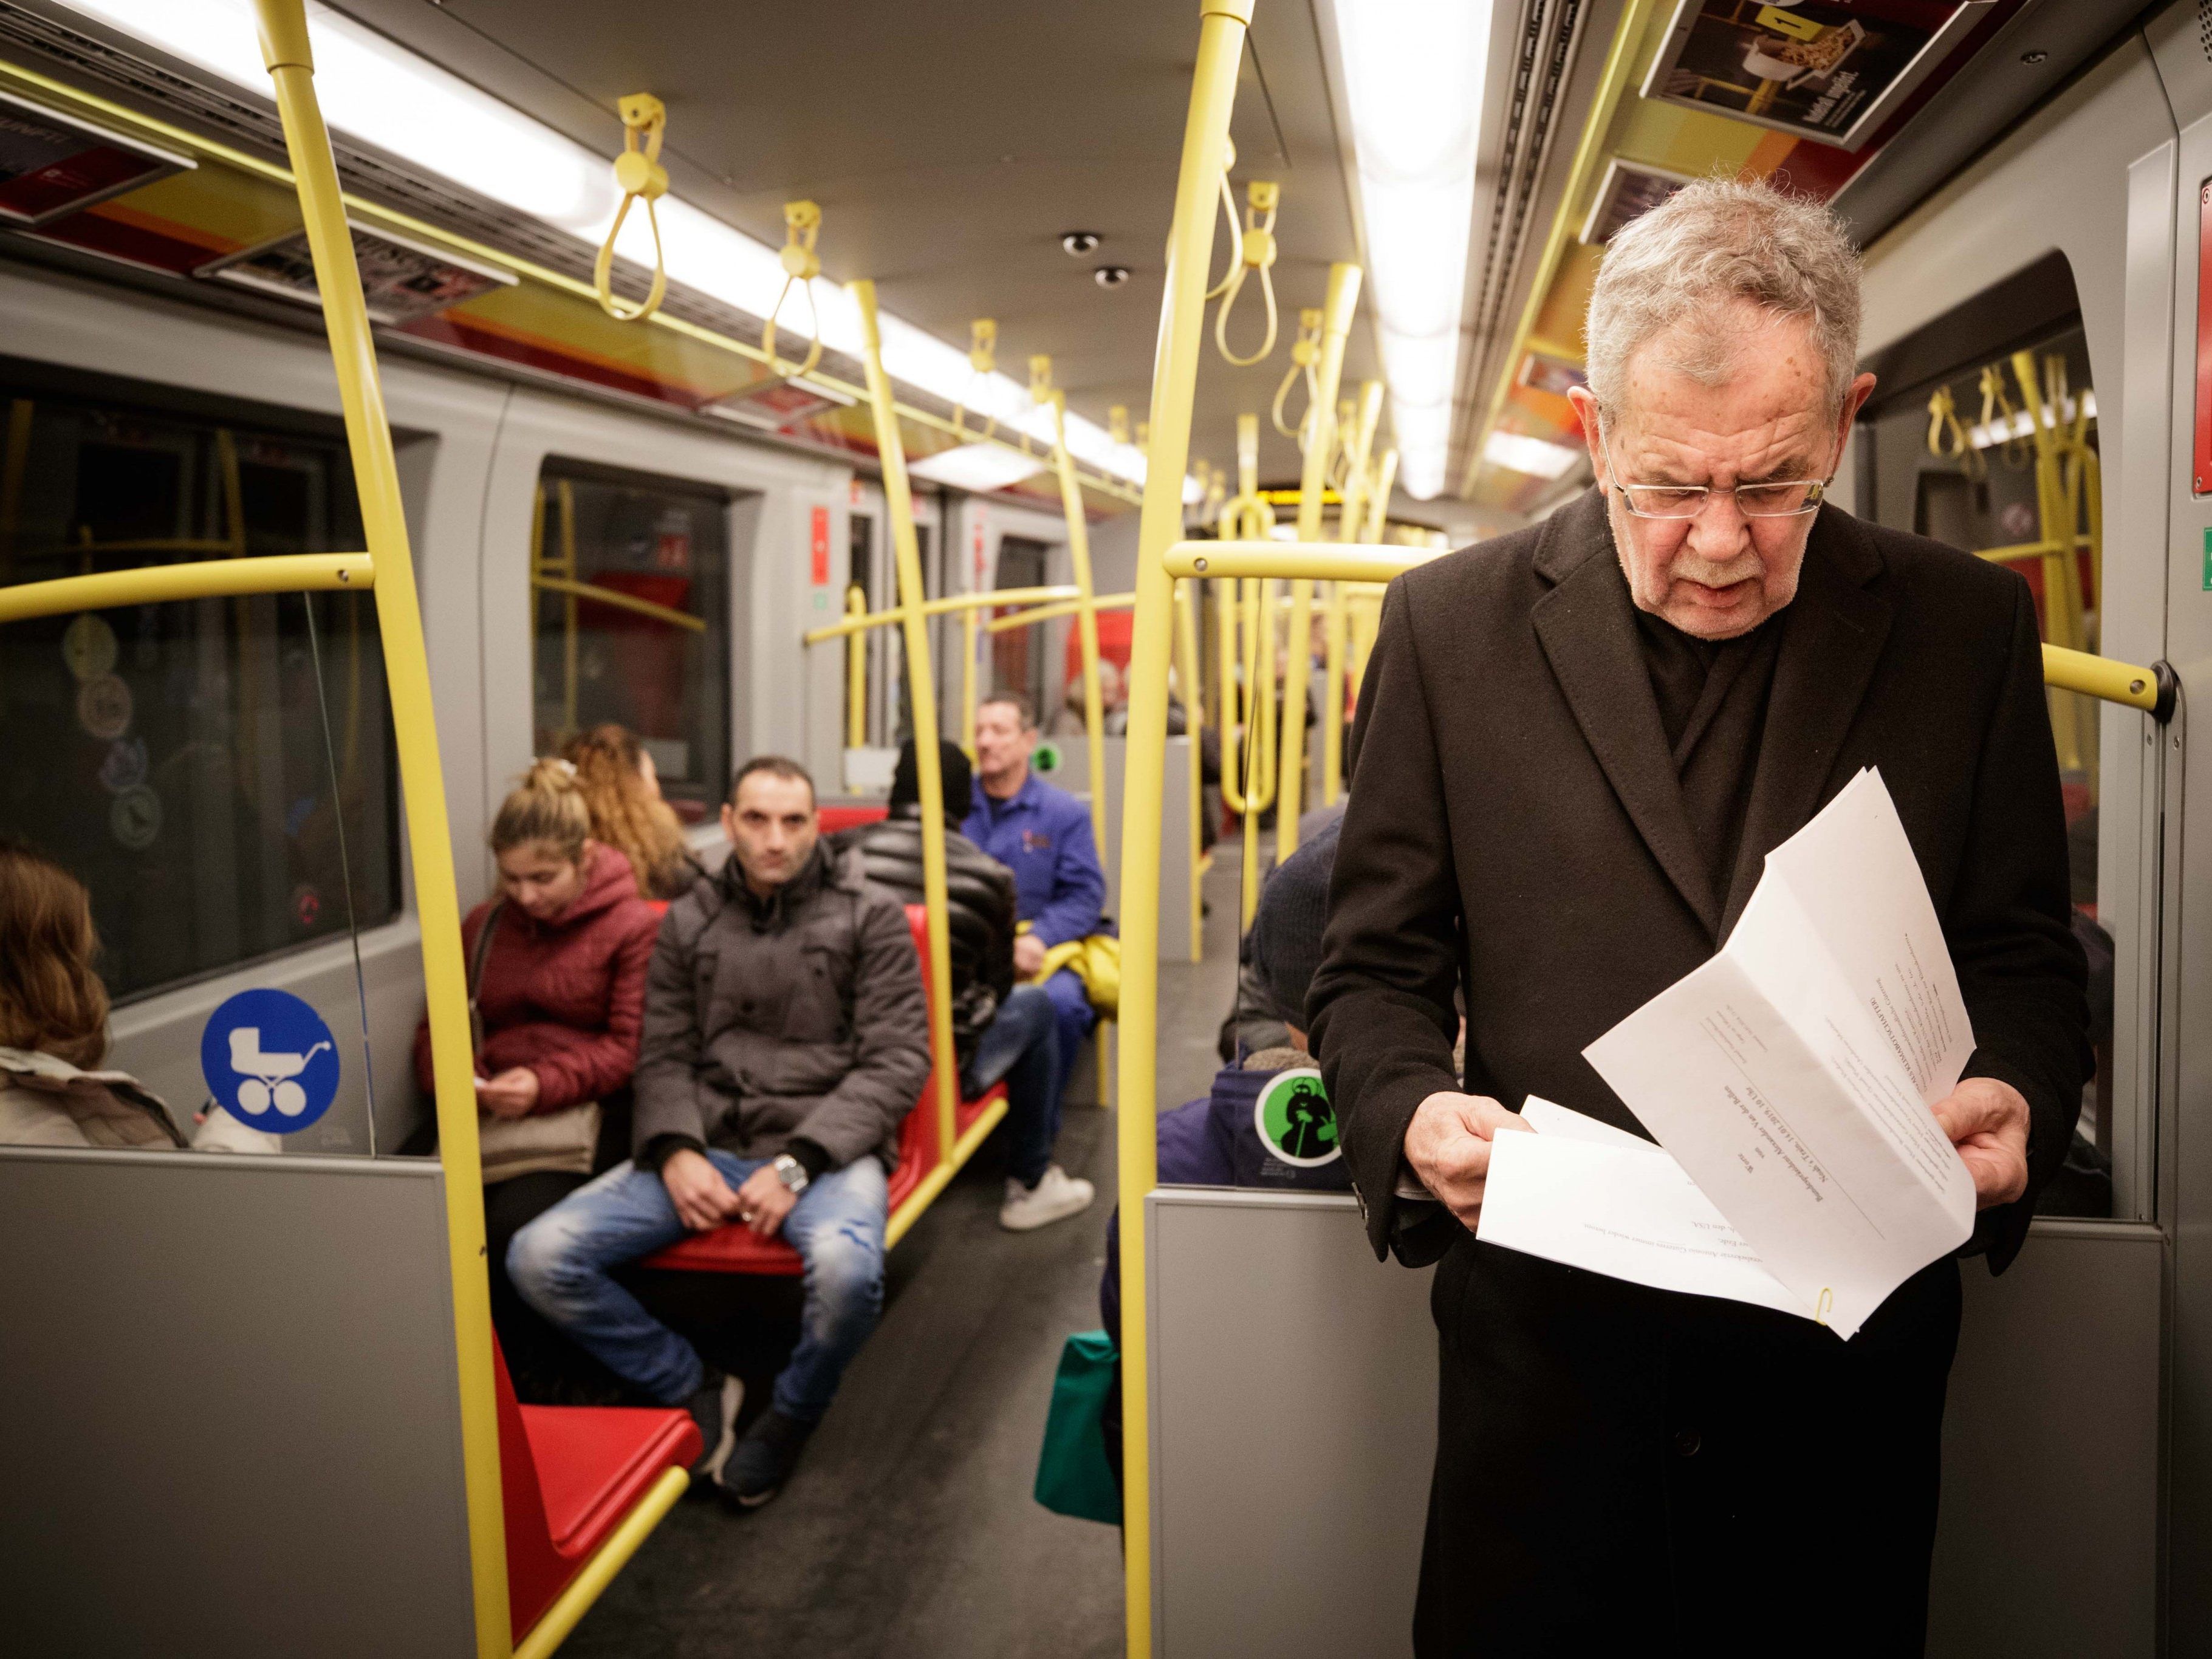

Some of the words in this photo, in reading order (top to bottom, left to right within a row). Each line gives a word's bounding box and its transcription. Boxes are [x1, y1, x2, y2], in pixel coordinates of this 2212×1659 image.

[1870, 997, 1911, 1071] KLIMABOTSCHAFTER)
[1724, 1084, 1741, 1105] Bellen
[1745, 1086, 1758, 1100] Uhr
[1739, 1104, 1749, 1114] der
[1755, 1099, 1765, 1108] 10
[1748, 1113, 1759, 1128] Van
[1758, 1126, 1784, 1155] Alexander
[1754, 1146, 1765, 1159] von
[1737, 1153, 1754, 1174] Worte
[1781, 1154, 1823, 1202] Bundespräsident
[1607, 1230, 1629, 1240] wieder
[1631, 1236, 1654, 1247] immer
[1688, 1248, 1718, 1257] Antonio
